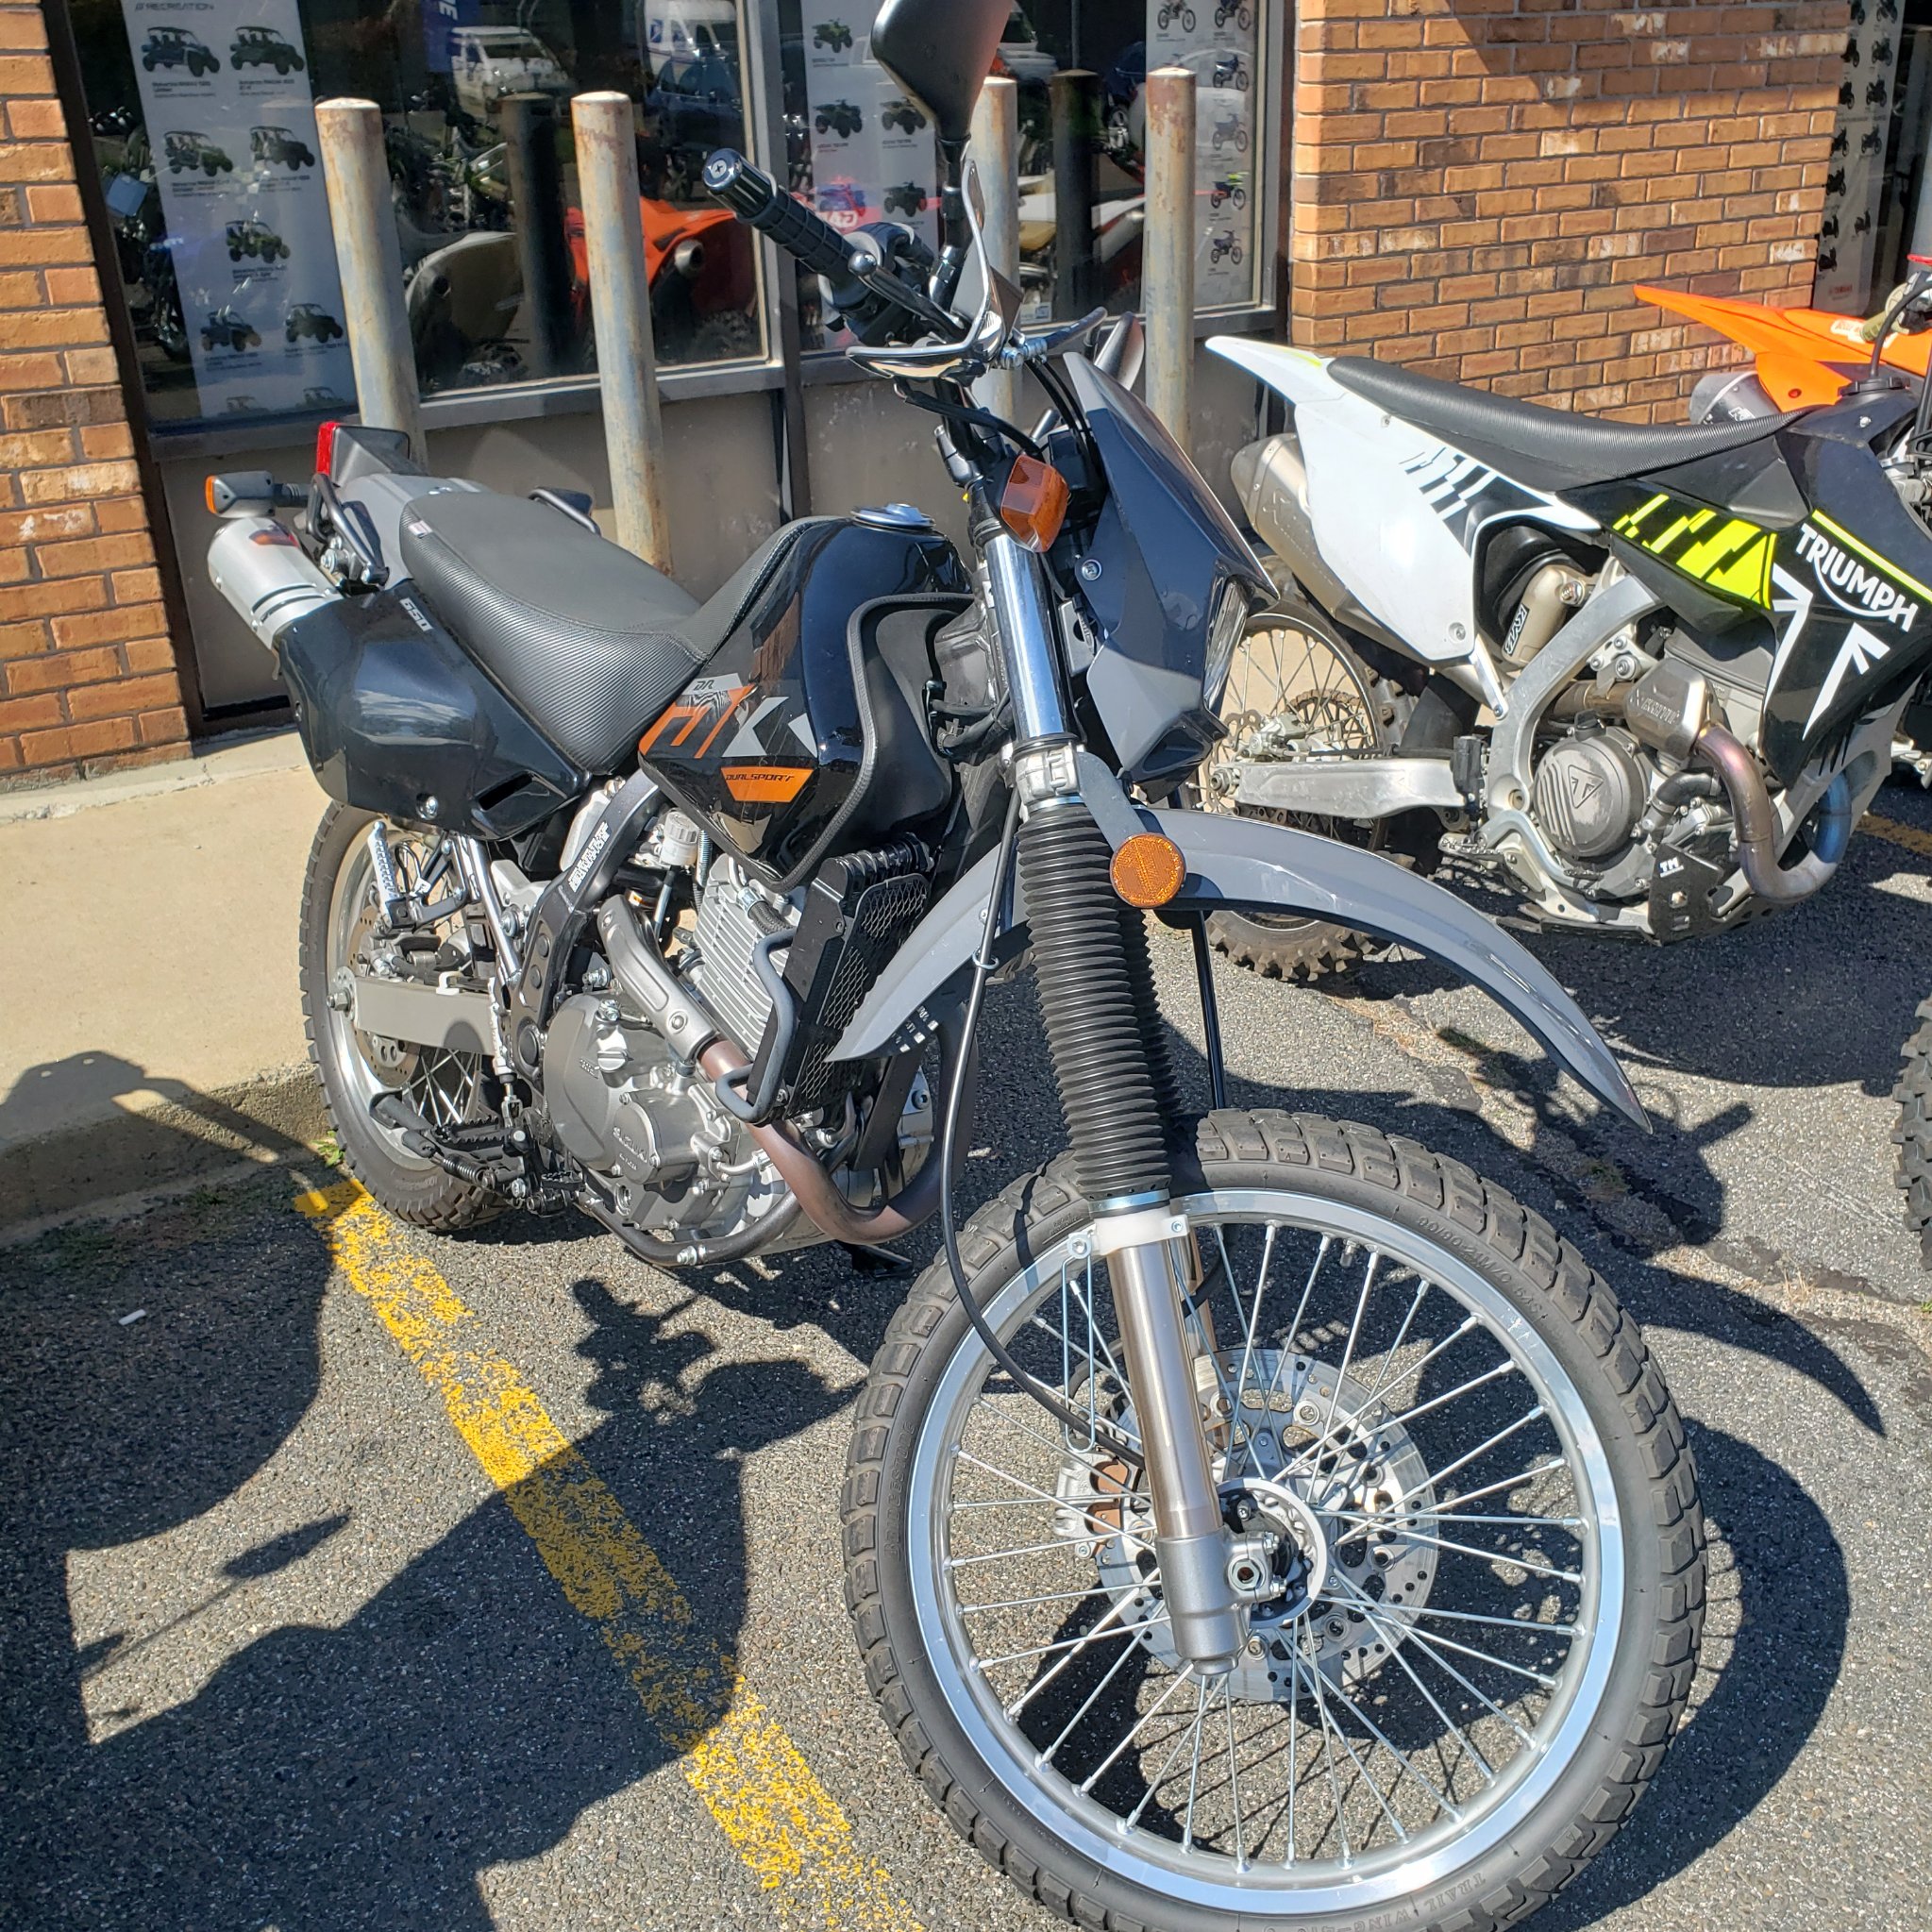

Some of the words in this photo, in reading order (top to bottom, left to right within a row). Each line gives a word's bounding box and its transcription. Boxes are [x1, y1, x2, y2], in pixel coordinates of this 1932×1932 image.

[1795, 522, 1919, 632] TRIUMPH
[399, 596, 434, 632] 650
[725, 774, 795, 782] DUALSPORT
[1659, 857, 1680, 874] TM
[1425, 1872, 1487, 1910] TRAIL
